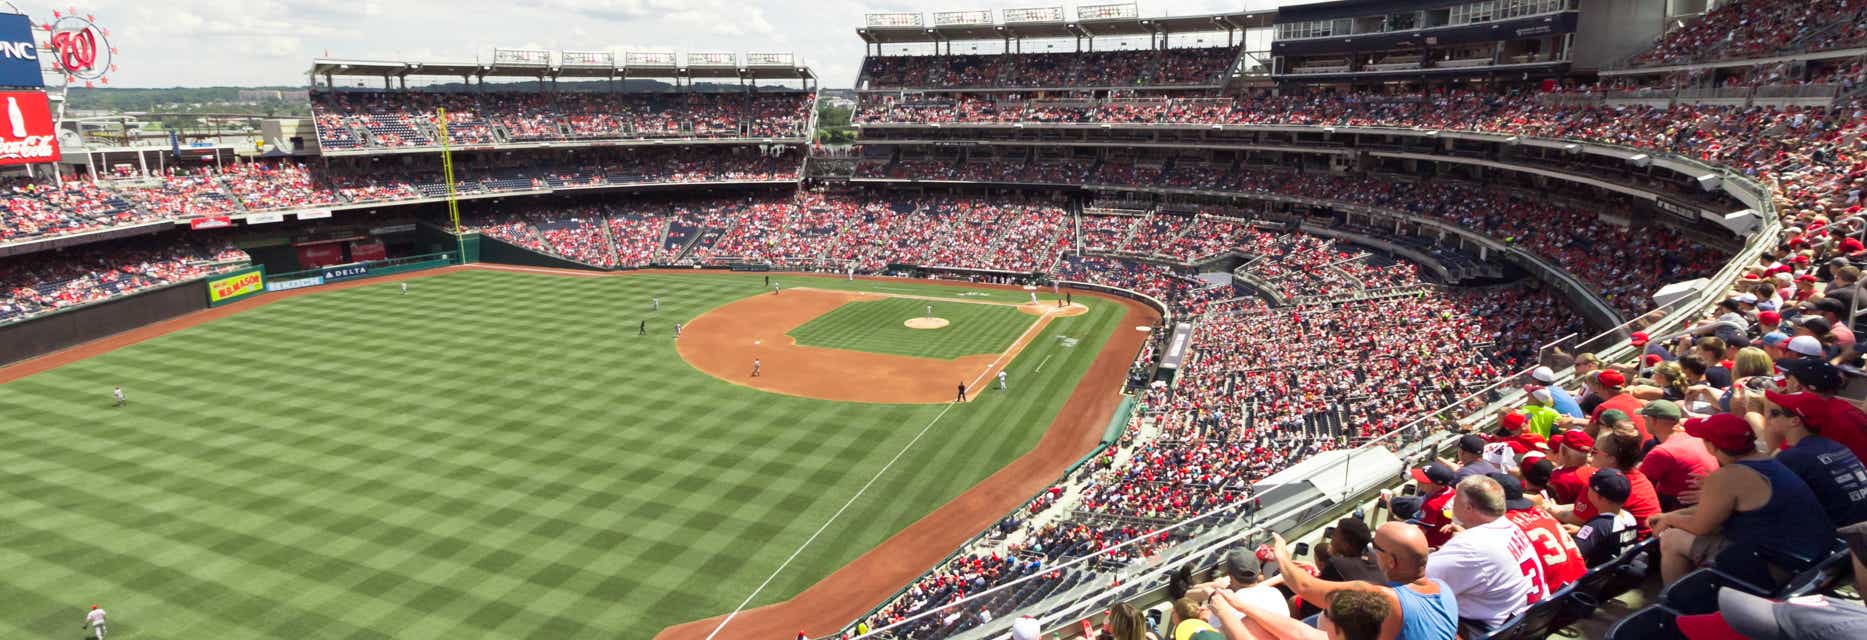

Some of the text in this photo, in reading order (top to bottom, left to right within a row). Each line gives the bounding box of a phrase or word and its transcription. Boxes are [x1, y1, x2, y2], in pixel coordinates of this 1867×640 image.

[232, 275, 260, 291] MASON
[335, 266, 366, 277] DELTA
[1506, 529, 1529, 562] HAR
[1527, 521, 1583, 567] 34
